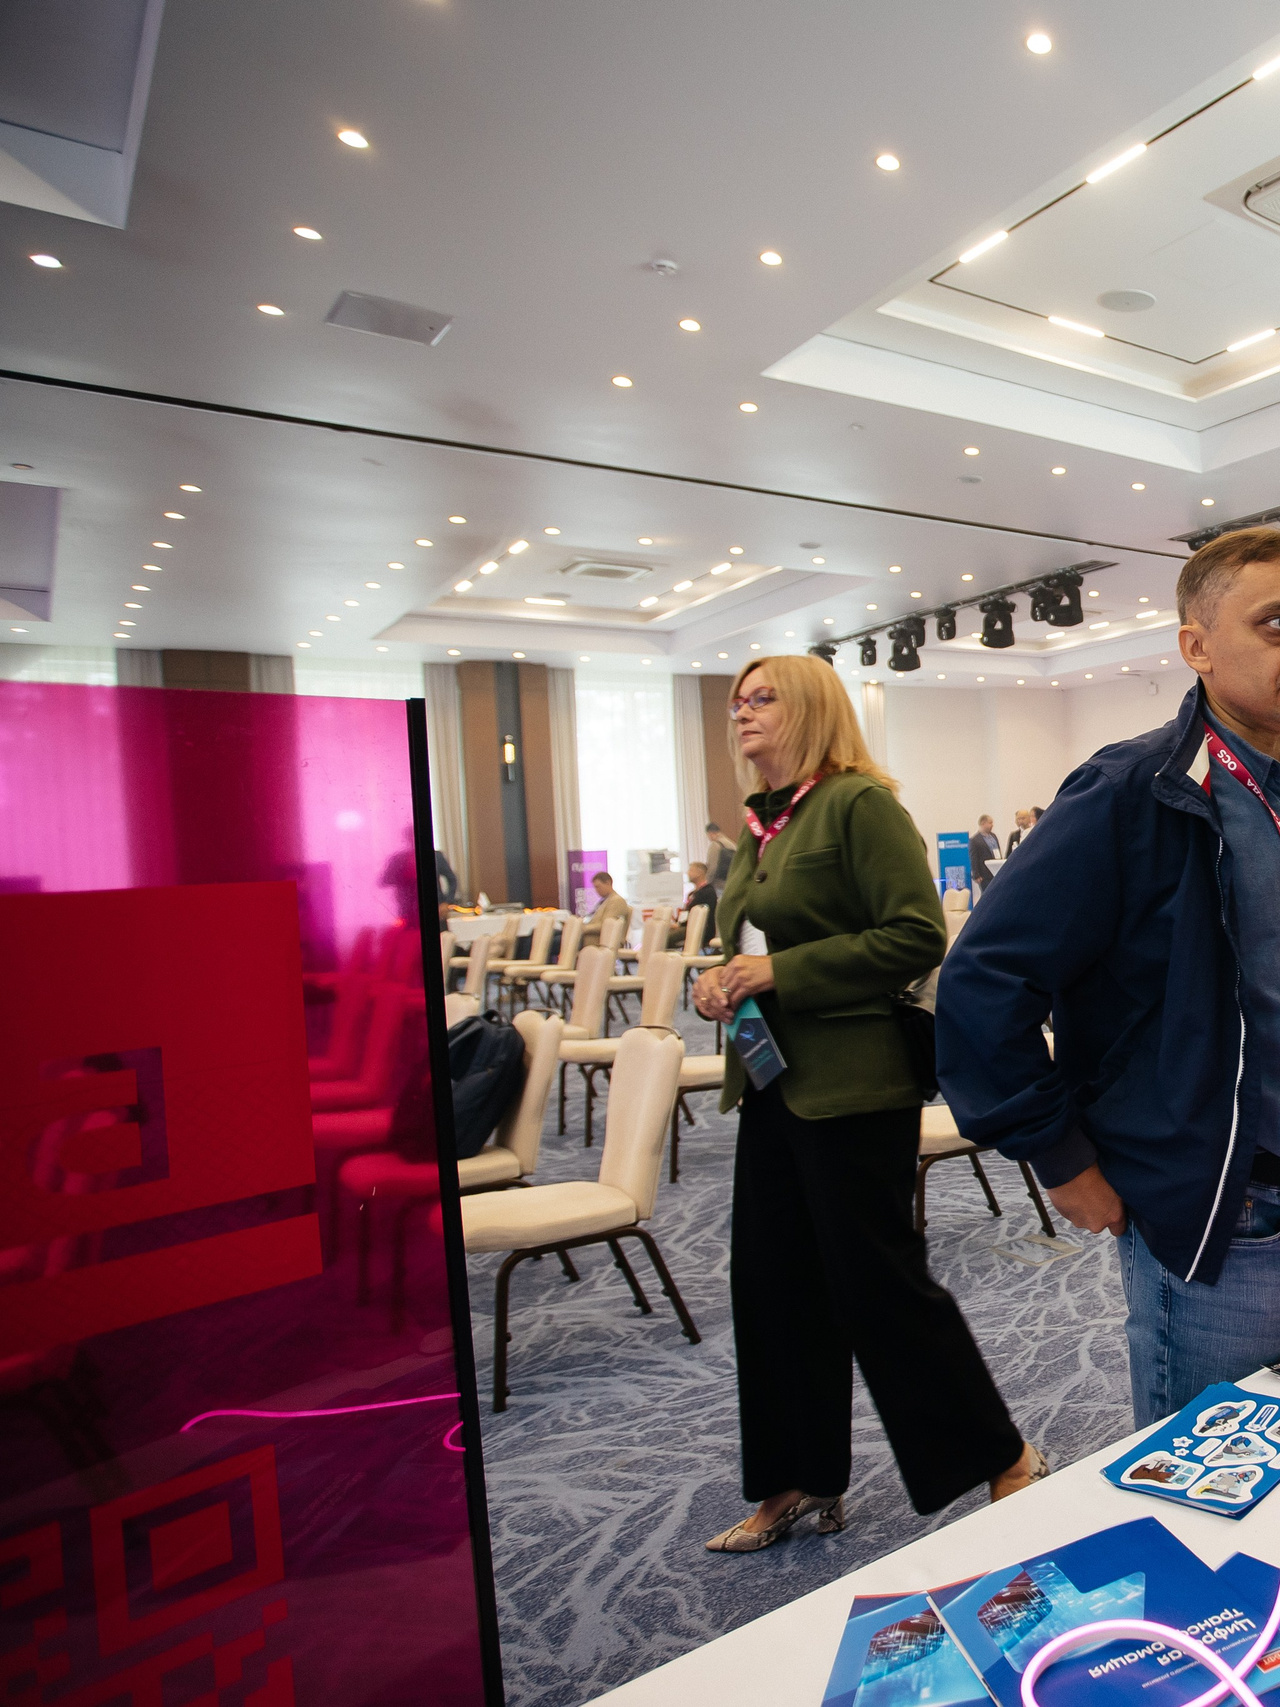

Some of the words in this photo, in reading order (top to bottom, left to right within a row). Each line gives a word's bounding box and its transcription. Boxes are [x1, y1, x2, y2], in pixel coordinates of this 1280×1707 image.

[1217, 749, 1237, 771] OCS
[1088, 1608, 1244, 1679] трансрмация
[1156, 1618, 1257, 1666] Цифрая
